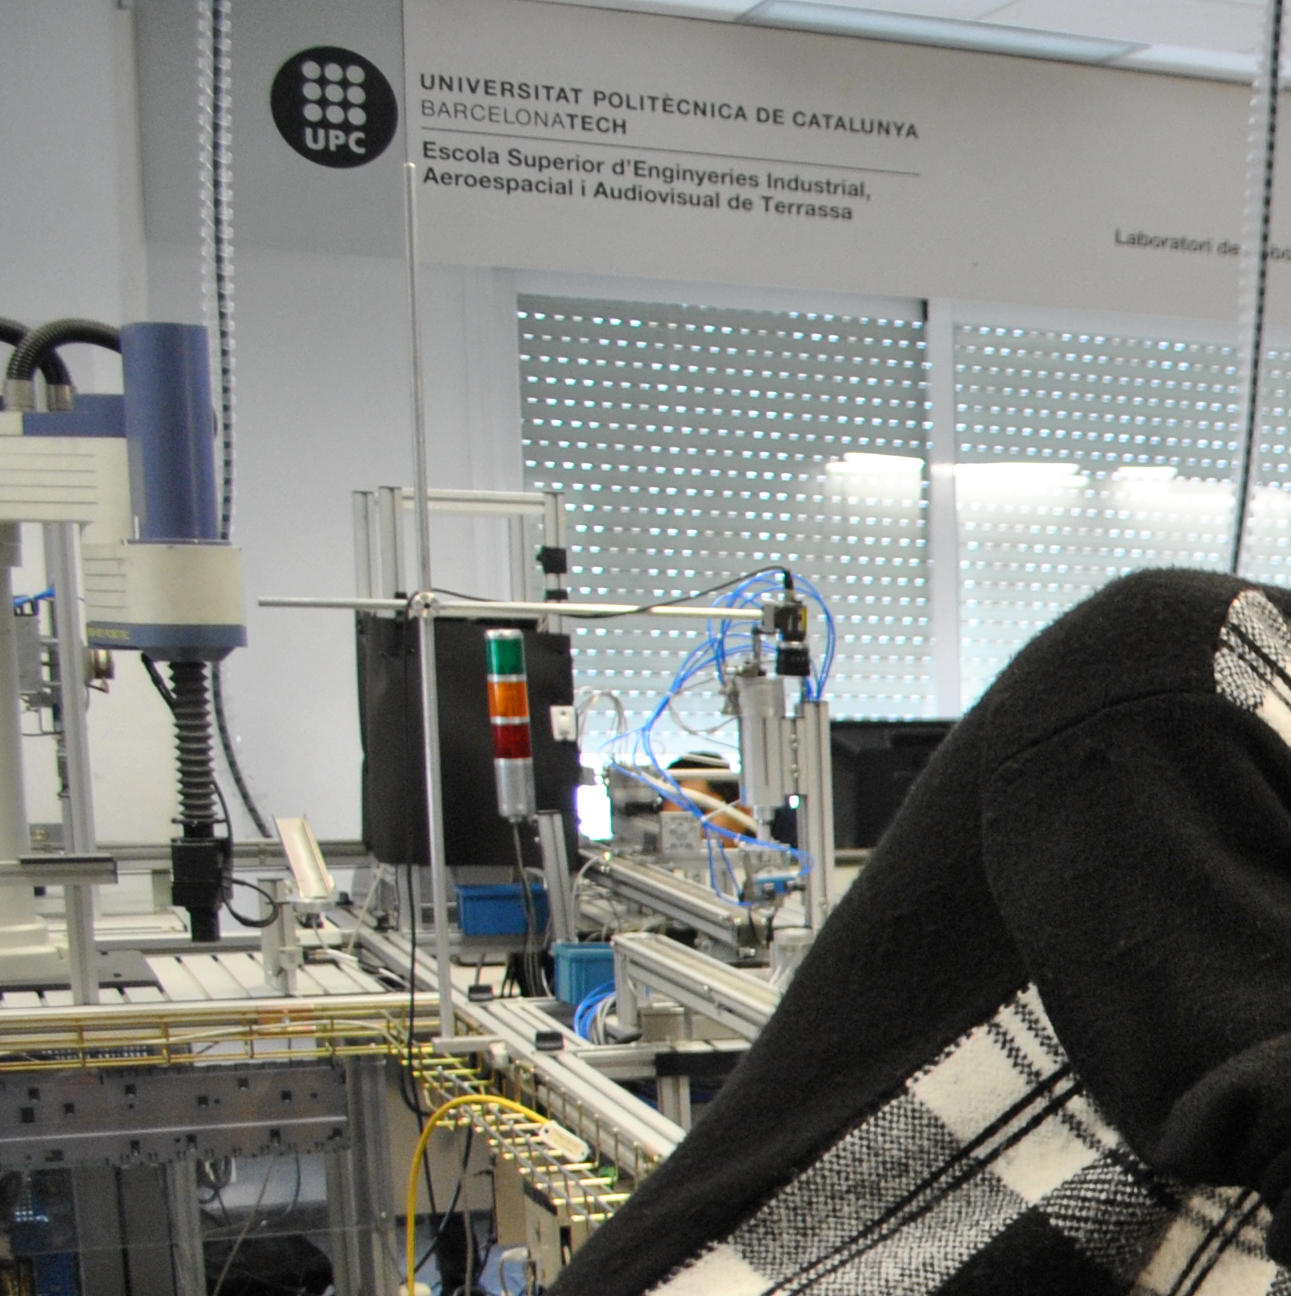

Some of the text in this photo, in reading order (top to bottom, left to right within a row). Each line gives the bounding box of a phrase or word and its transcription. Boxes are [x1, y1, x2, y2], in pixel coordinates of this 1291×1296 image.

[420, 73, 919, 139] UNIVERSITAT POLITÈCNICA DE CATALUNYA
[421, 100, 627, 135] BARCELONATECH
[304, 127, 367, 155] UPC
[422, 141, 871, 201] Escola Superior d'Enginyeries Industrial,
[423, 167, 854, 221] Aeroespacial i Audiovisual de Terrassa
[1114, 228, 1211, 253] Laboratori
[1218, 241, 1241, 256] de
